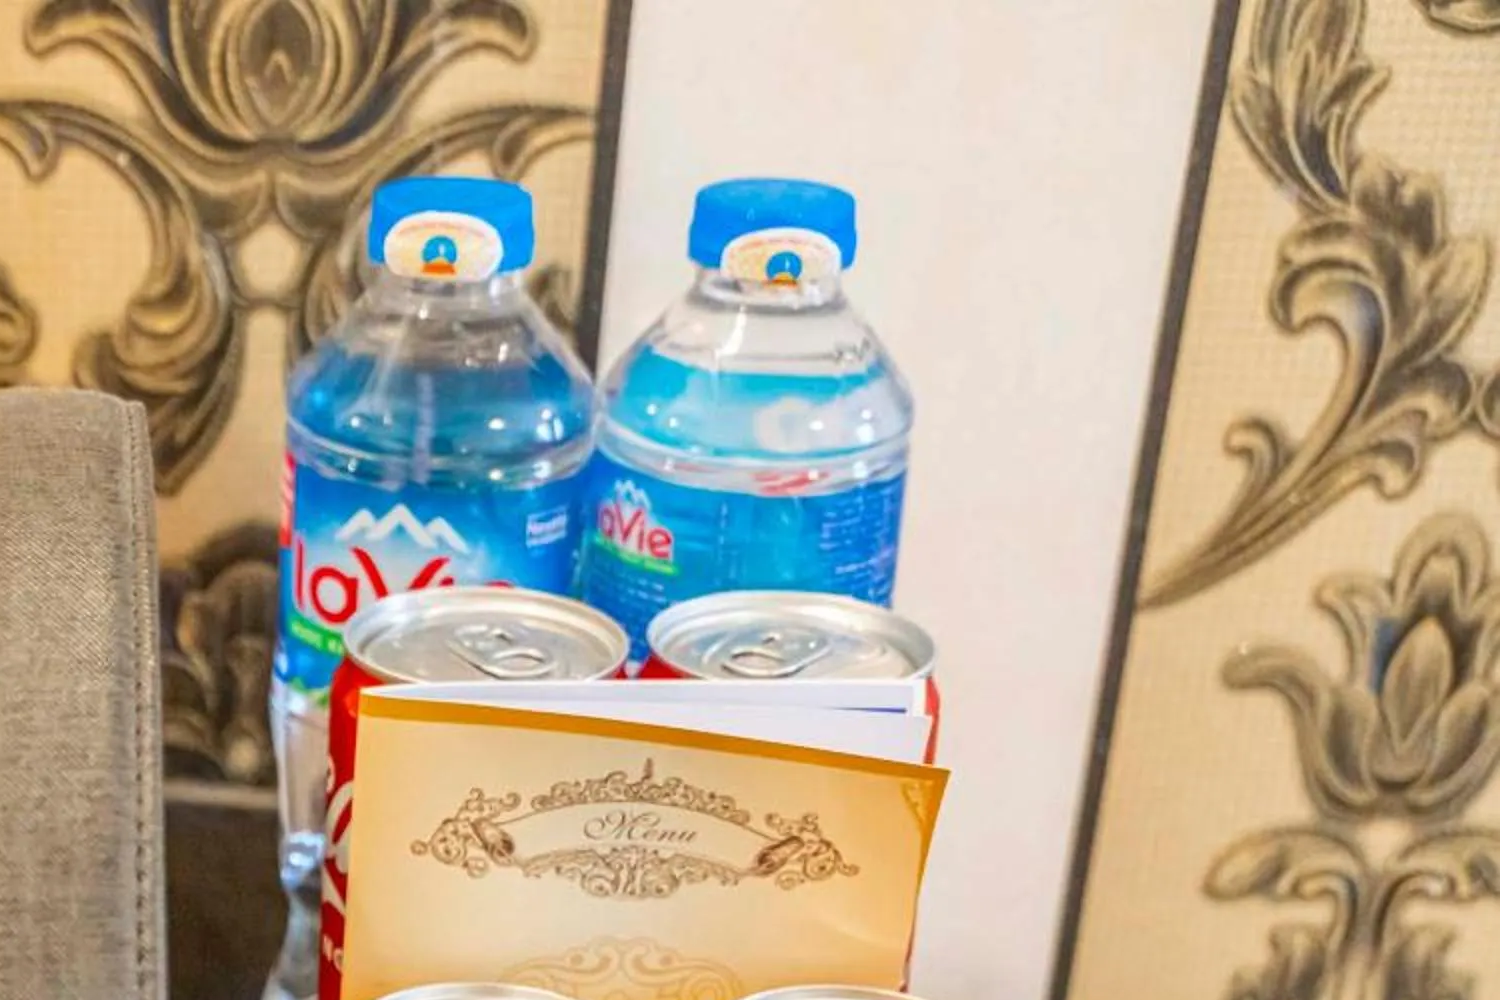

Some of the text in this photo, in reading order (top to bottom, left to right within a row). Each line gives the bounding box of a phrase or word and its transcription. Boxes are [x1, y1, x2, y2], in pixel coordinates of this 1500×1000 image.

[599, 502, 673, 560] aVie
[296, 535, 514, 625] laV
[584, 808, 698, 842] Menu
